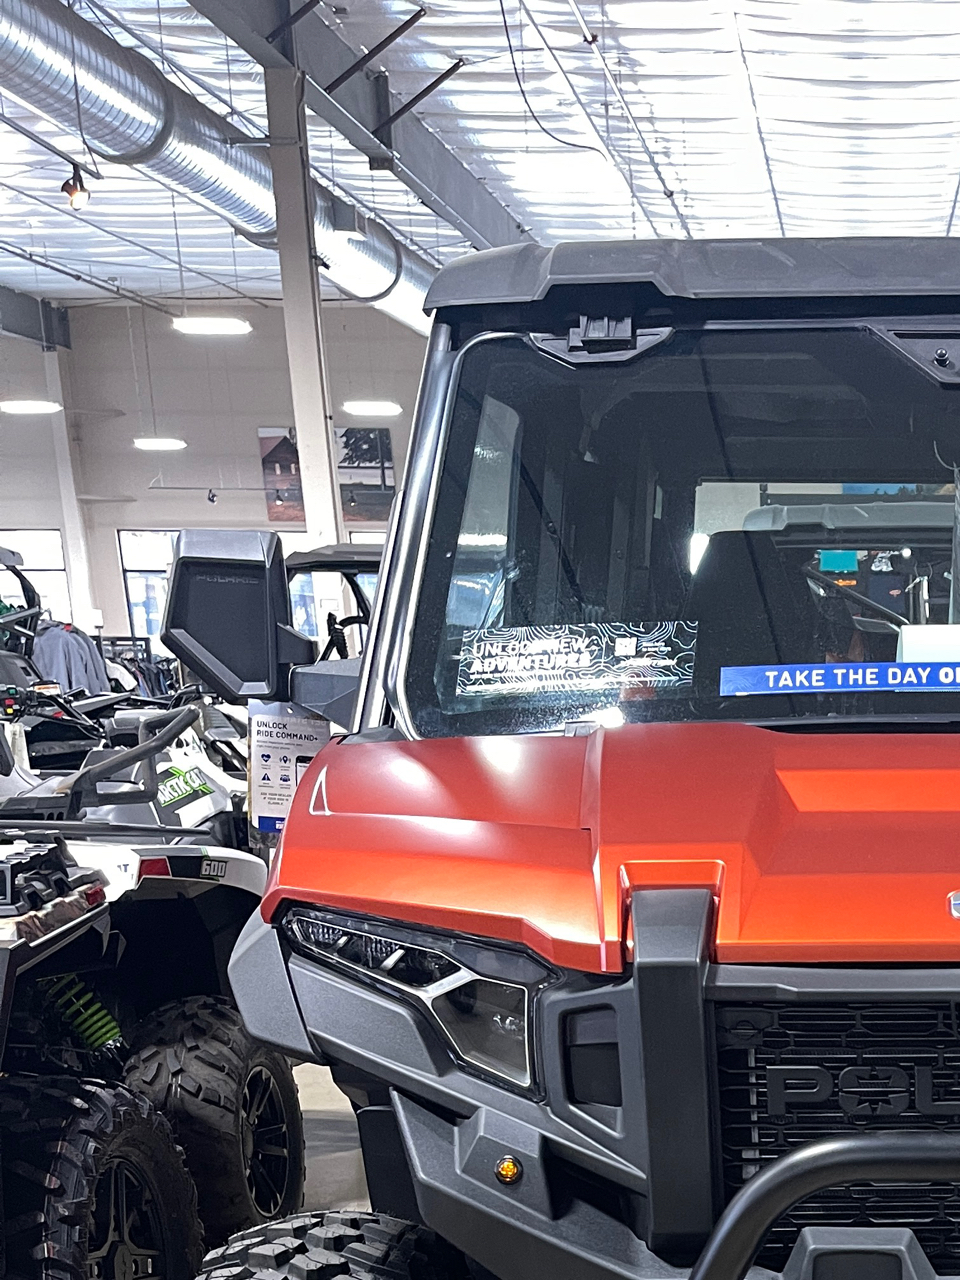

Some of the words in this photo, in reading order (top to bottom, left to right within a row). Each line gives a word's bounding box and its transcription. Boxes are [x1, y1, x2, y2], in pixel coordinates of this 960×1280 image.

[765, 669, 825, 688] TAKE
[833, 668, 879, 686] THE
[887, 667, 931, 684] DAY
[256, 720, 288, 730] UNLOCK
[256, 729, 275, 738] RIDE
[157, 774, 192, 804] ARCTIC
[201, 861, 227, 877] 600
